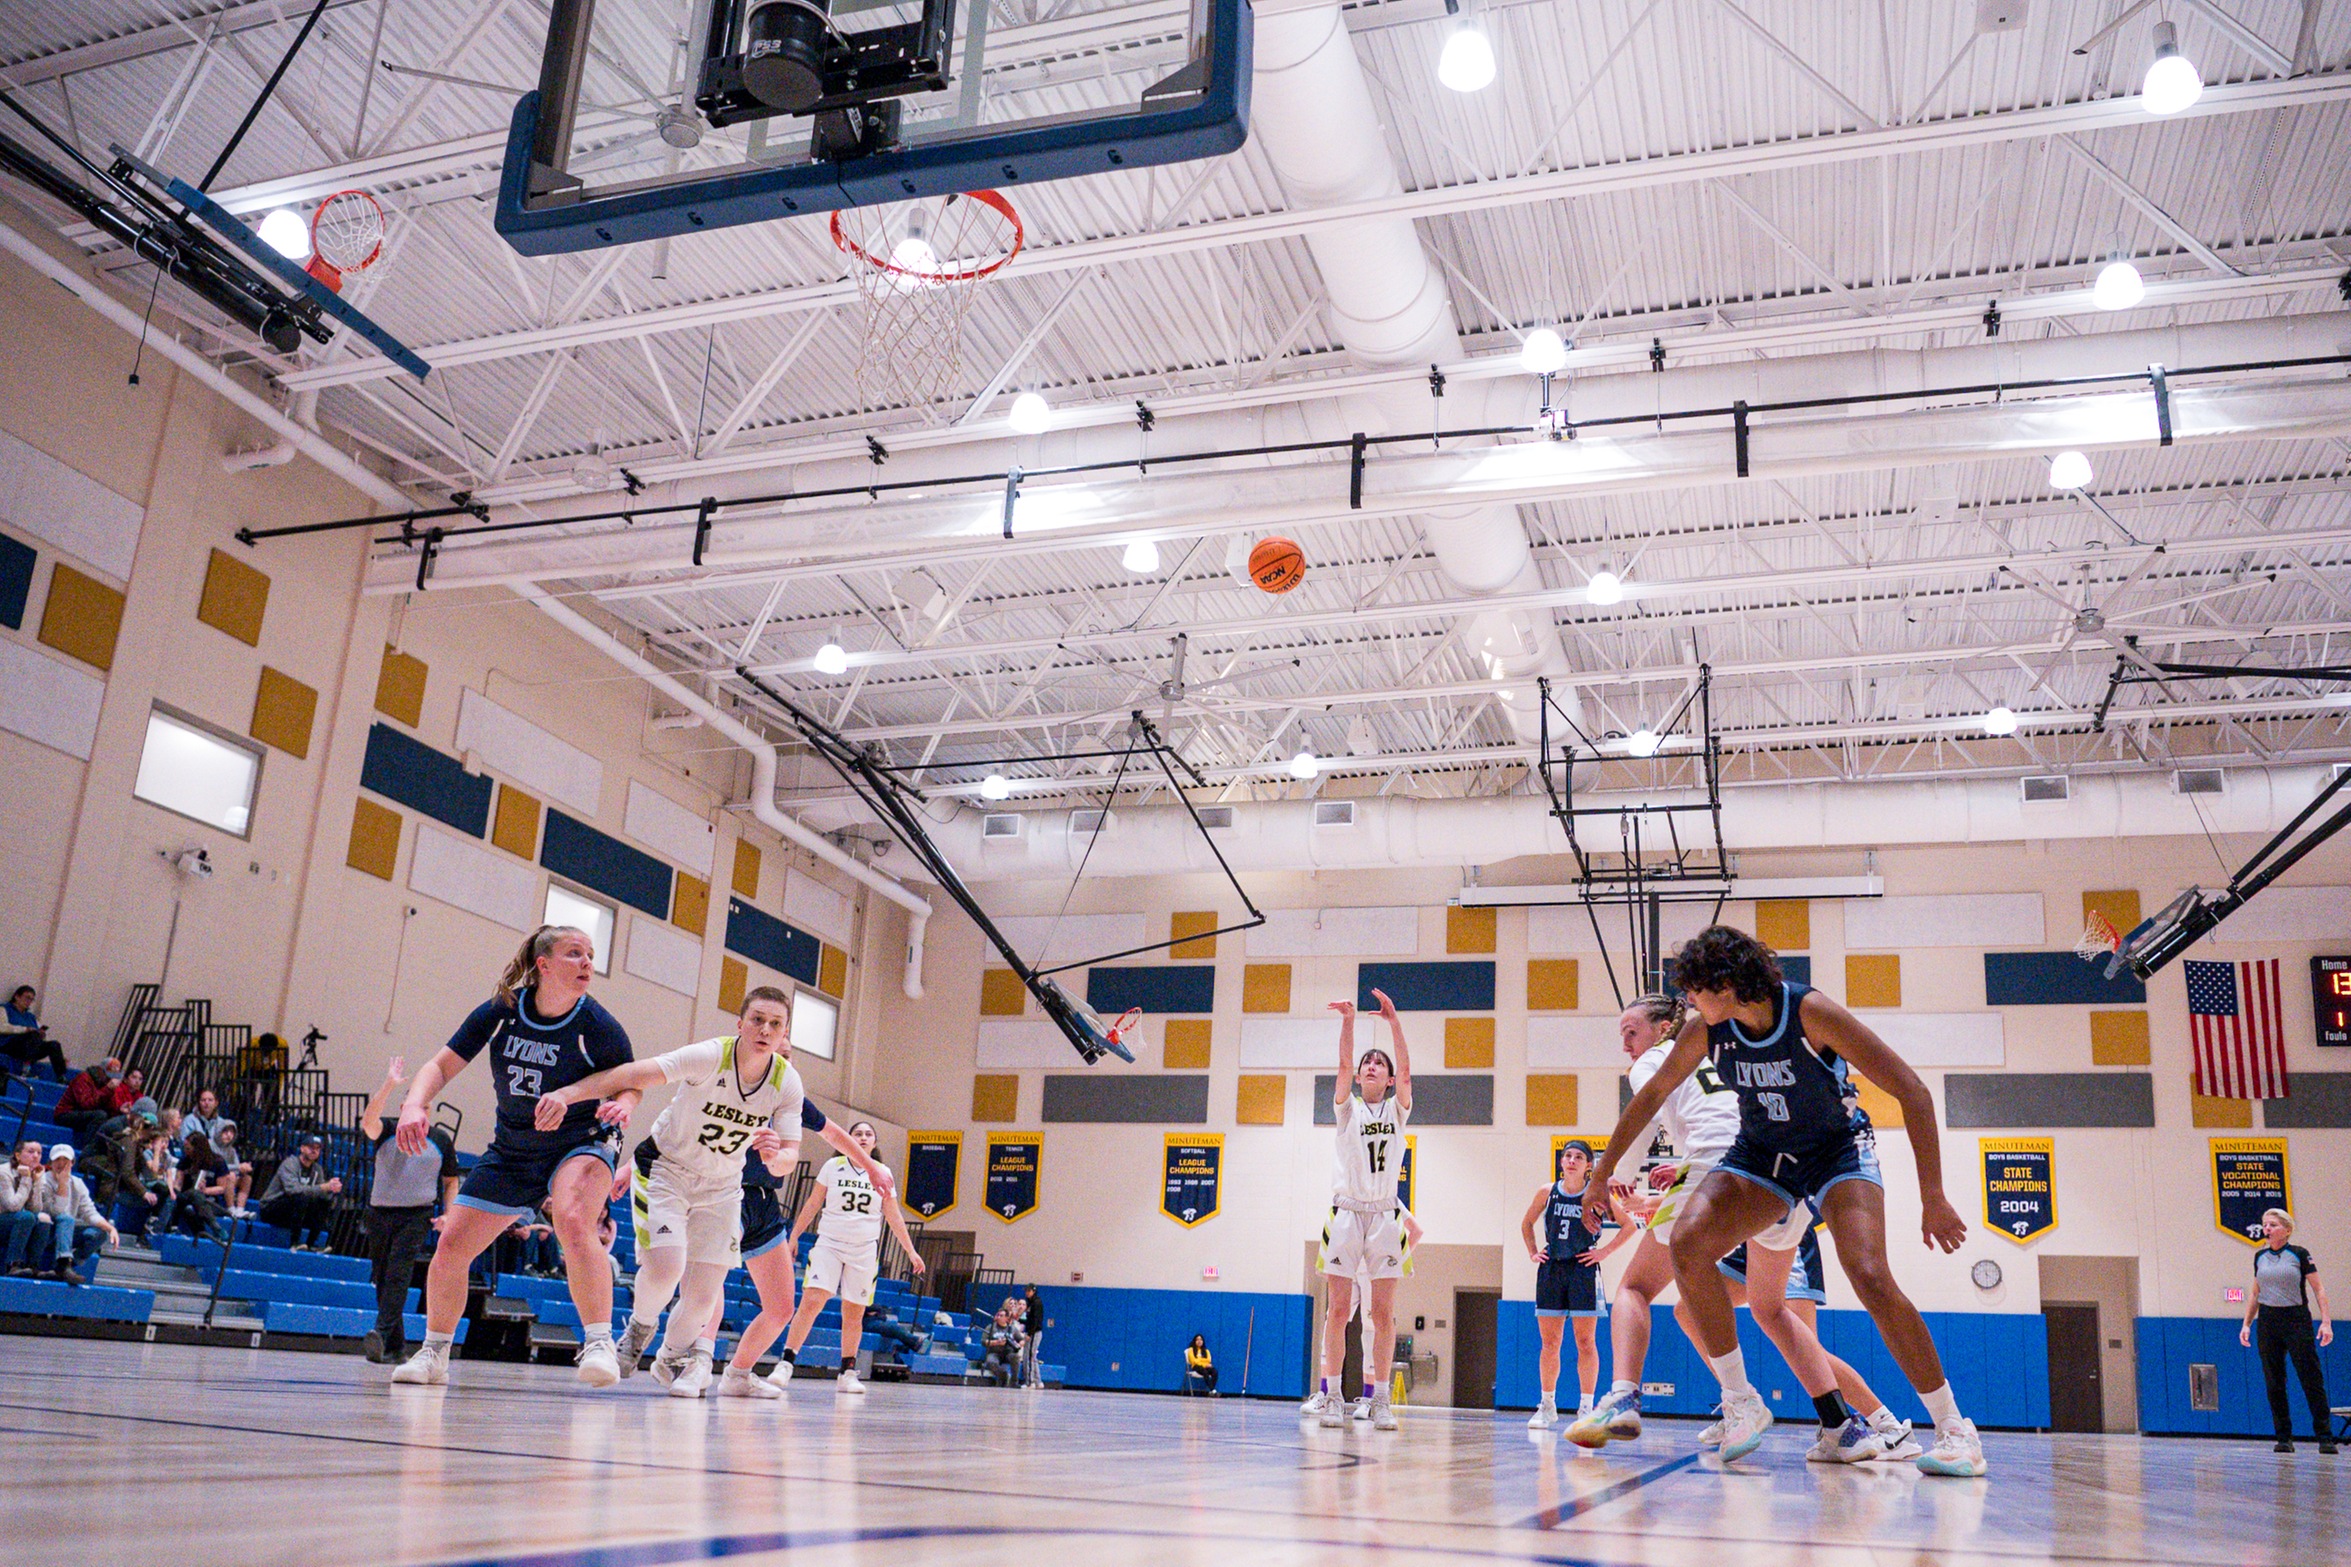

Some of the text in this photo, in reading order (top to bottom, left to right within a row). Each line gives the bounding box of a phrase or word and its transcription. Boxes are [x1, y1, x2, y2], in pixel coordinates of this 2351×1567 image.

[1260, 565, 1286, 585] NCAA
[2321, 959, 2348, 970] Home
[503, 1035, 560, 1067] LYONS
[1735, 1059, 1797, 1087] LYONS
[507, 1065, 543, 1099] 23
[1757, 1092, 1790, 1121] 10
[701, 1101, 768, 1127] LESLEY
[697, 1123, 750, 1155] 23
[911, 1134, 960, 1142] MINUTEMAN
[1167, 1137, 1221, 1145] MINUTEMAN
[1984, 1142, 2050, 1150] MINUTEMAN
[2214, 1142, 2283, 1150] MINUTEMAN
[1000, 1156, 1026, 1164] LEAGUE
[1367, 1139, 1388, 1173] 14
[991, 1164, 1034, 1172] CHAMPIONS
[1169, 1167, 1215, 1175] CHAMPIONS
[2235, 1162, 2265, 1171] STATE
[2003, 1167, 2033, 1179] STATE
[2221, 1171, 2281, 1180] VOCATIONAL
[837, 1179, 876, 1191] LESLE
[1989, 1180, 2048, 1193] CHAMPIONS
[2222, 1181, 2281, 1190] CHAMPIONS
[841, 1190, 872, 1214] 32
[2000, 1200, 2040, 1213] 2004
[1553, 1203, 1583, 1219] LYONS
[1558, 1219, 1571, 1240] 3
